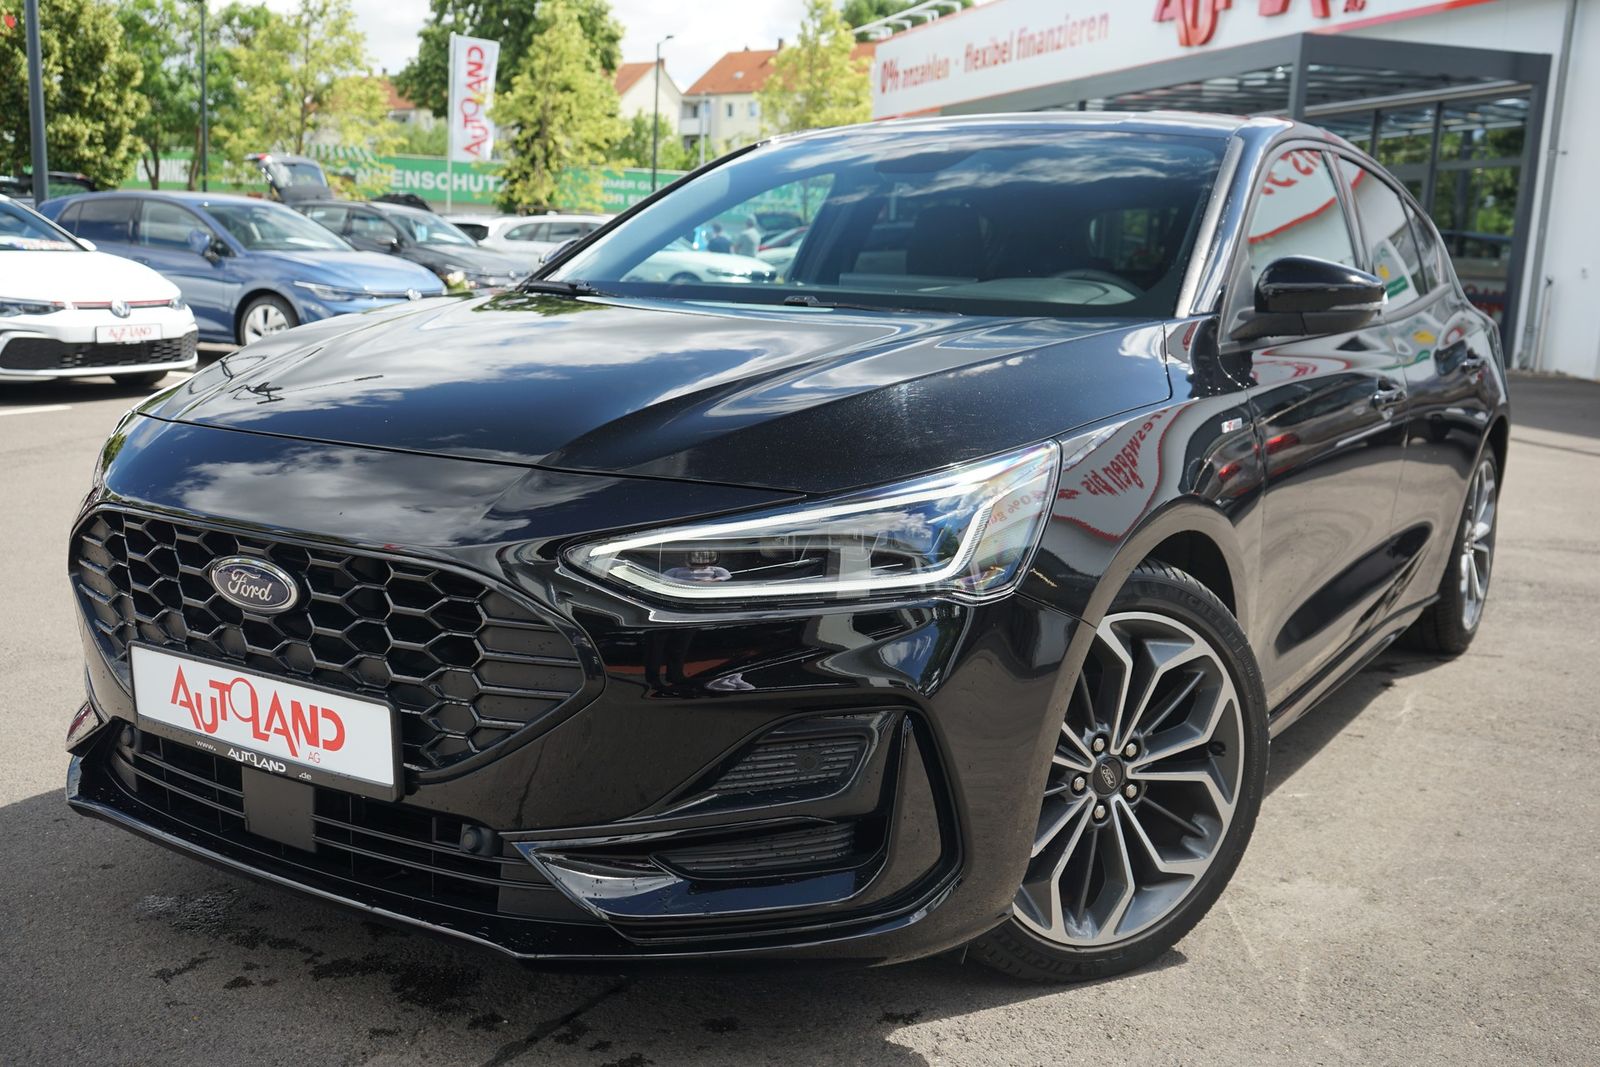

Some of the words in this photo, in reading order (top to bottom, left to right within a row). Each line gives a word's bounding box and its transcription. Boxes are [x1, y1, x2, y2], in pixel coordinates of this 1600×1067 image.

[964, 31, 1014, 73] flexibel
[1016, 13, 1110, 60] finanzieren
[227, 568, 273, 602] Ford
[170, 664, 346, 758] AUTOLAND
[228, 748, 286, 773] AUTOLAND
[307, 751, 321, 764] AG
